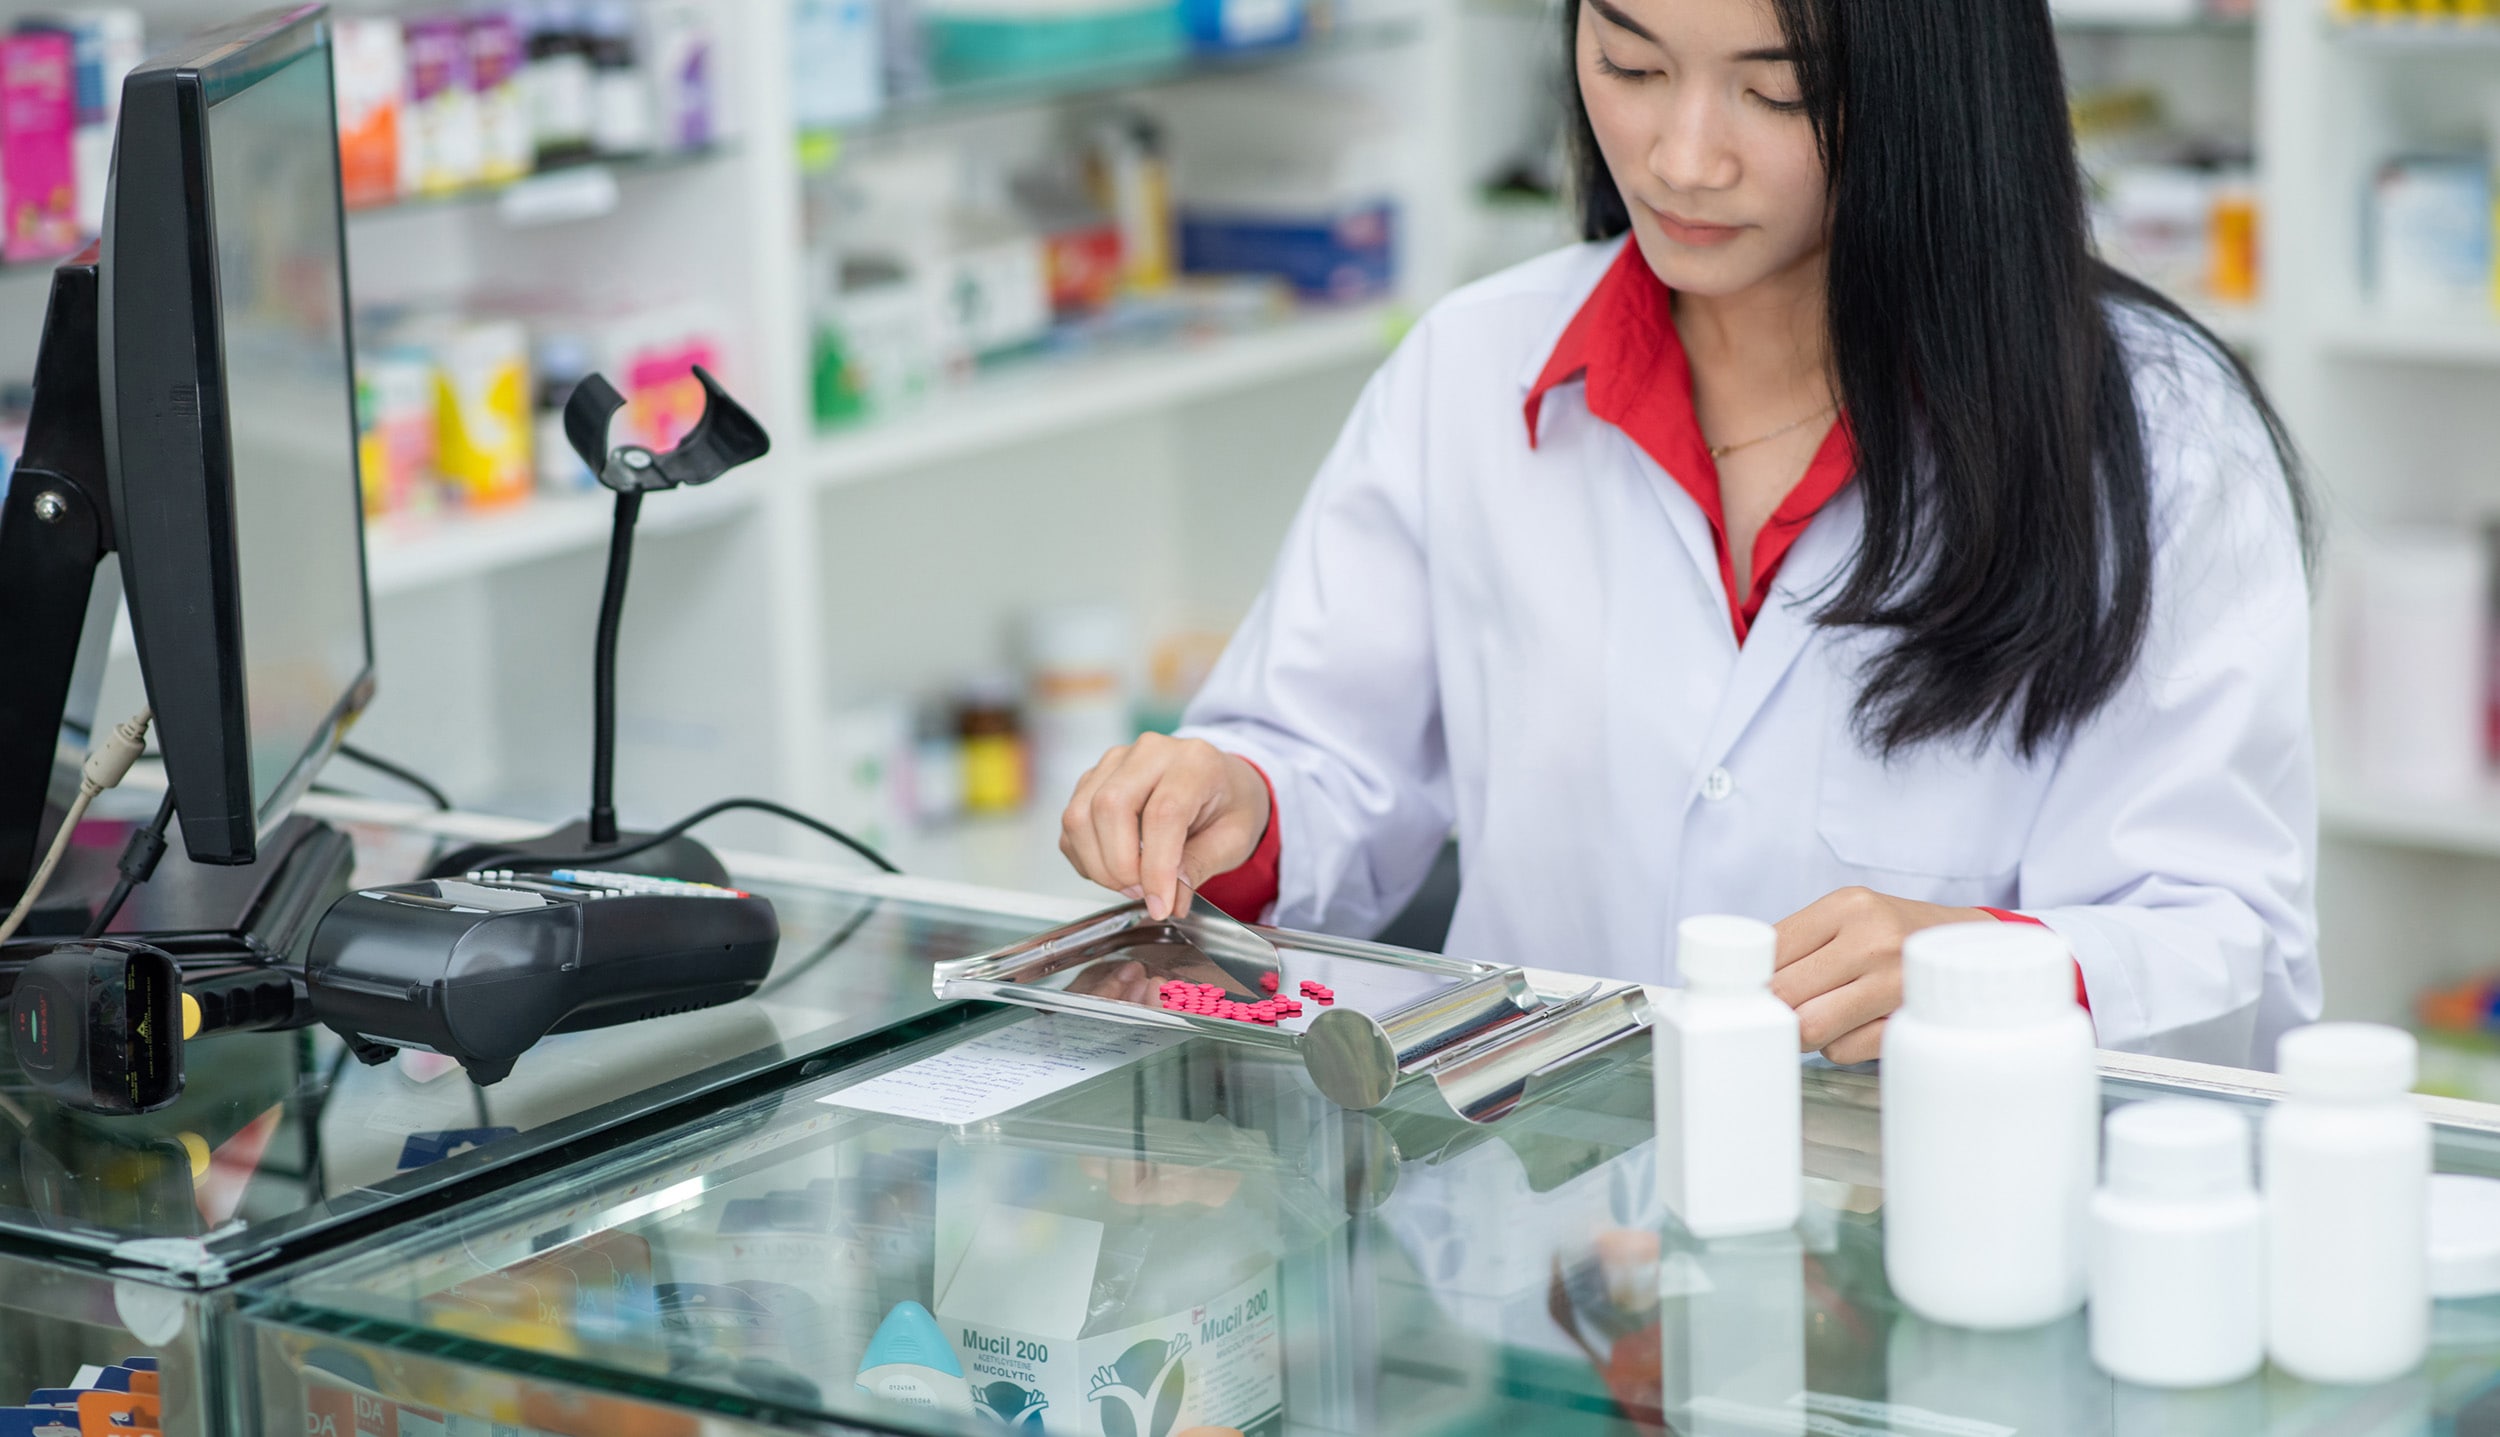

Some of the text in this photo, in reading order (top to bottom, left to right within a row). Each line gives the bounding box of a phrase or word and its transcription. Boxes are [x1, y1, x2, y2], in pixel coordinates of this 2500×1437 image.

[1201, 1304, 1242, 1345] Mucil
[1246, 1288, 1268, 1321] 200
[963, 1328, 1048, 1363] Mucil 200
[973, 1362, 1036, 1383] MUCOLYTIC
[978, 1353, 1032, 1371] ACETYLCYSTEINE
